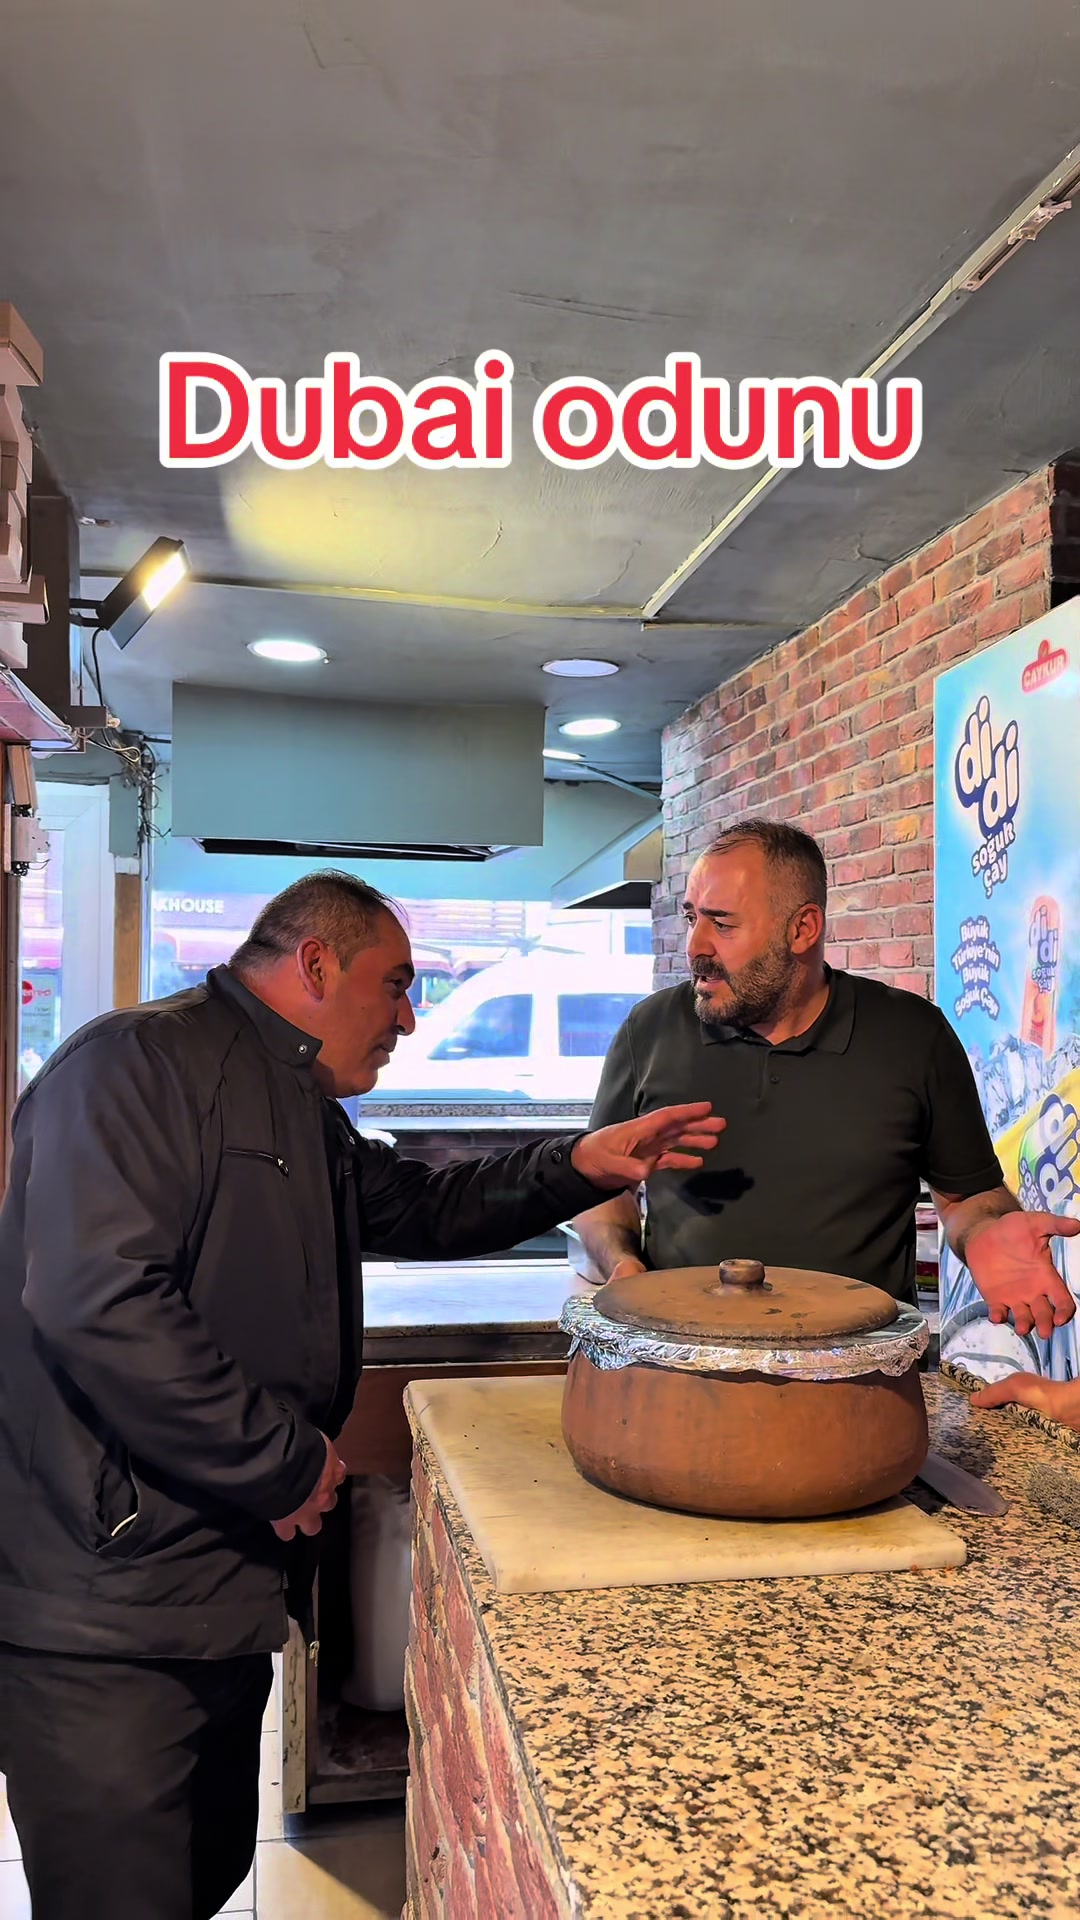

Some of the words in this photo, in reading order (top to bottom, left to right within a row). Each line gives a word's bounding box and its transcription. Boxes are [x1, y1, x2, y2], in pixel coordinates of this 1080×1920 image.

[957, 697, 992, 795] di
[983, 723, 1018, 829] di
[984, 853, 1007, 896] çay
[960, 920, 989, 942] Büyük
[962, 963, 989, 984] Büyük
